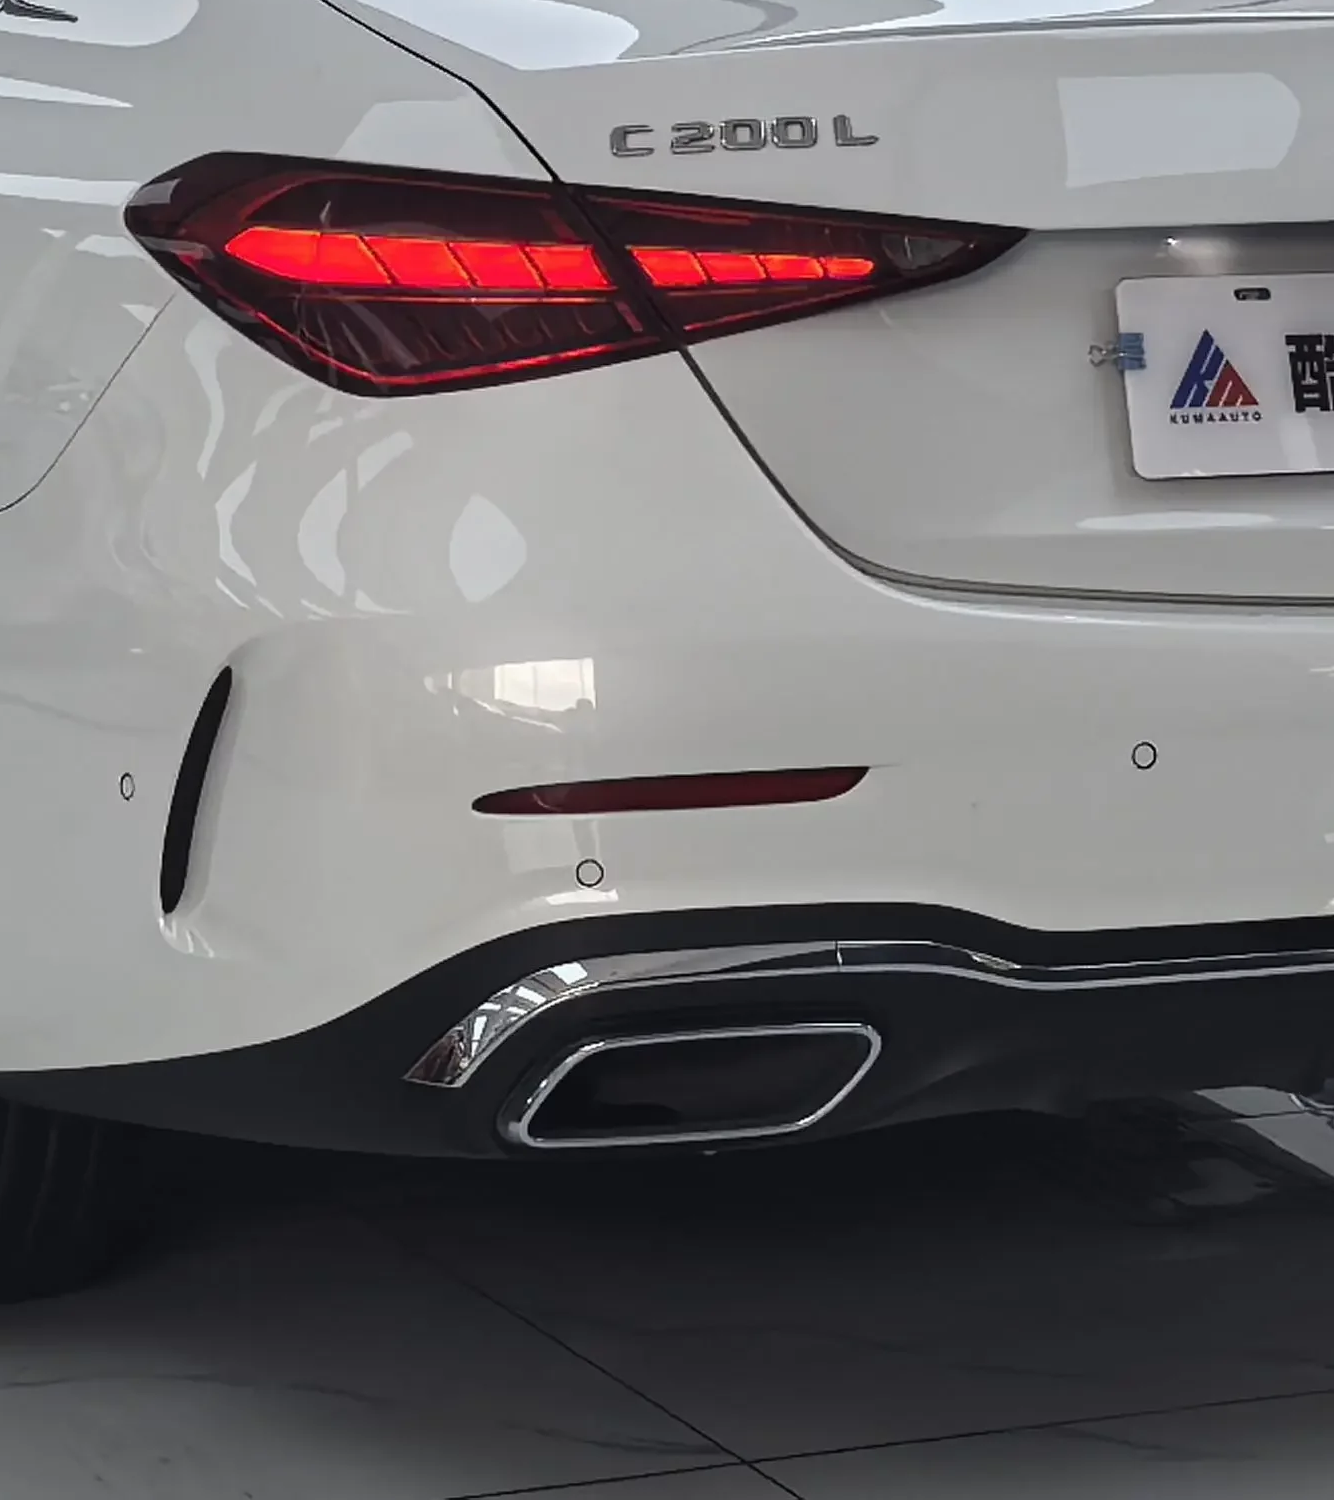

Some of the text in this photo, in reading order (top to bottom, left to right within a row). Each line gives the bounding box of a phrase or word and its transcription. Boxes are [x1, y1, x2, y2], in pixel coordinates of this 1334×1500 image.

[610, 114, 880, 157] C 200 L
[1169, 410, 1263, 425] KUMAAUTO
